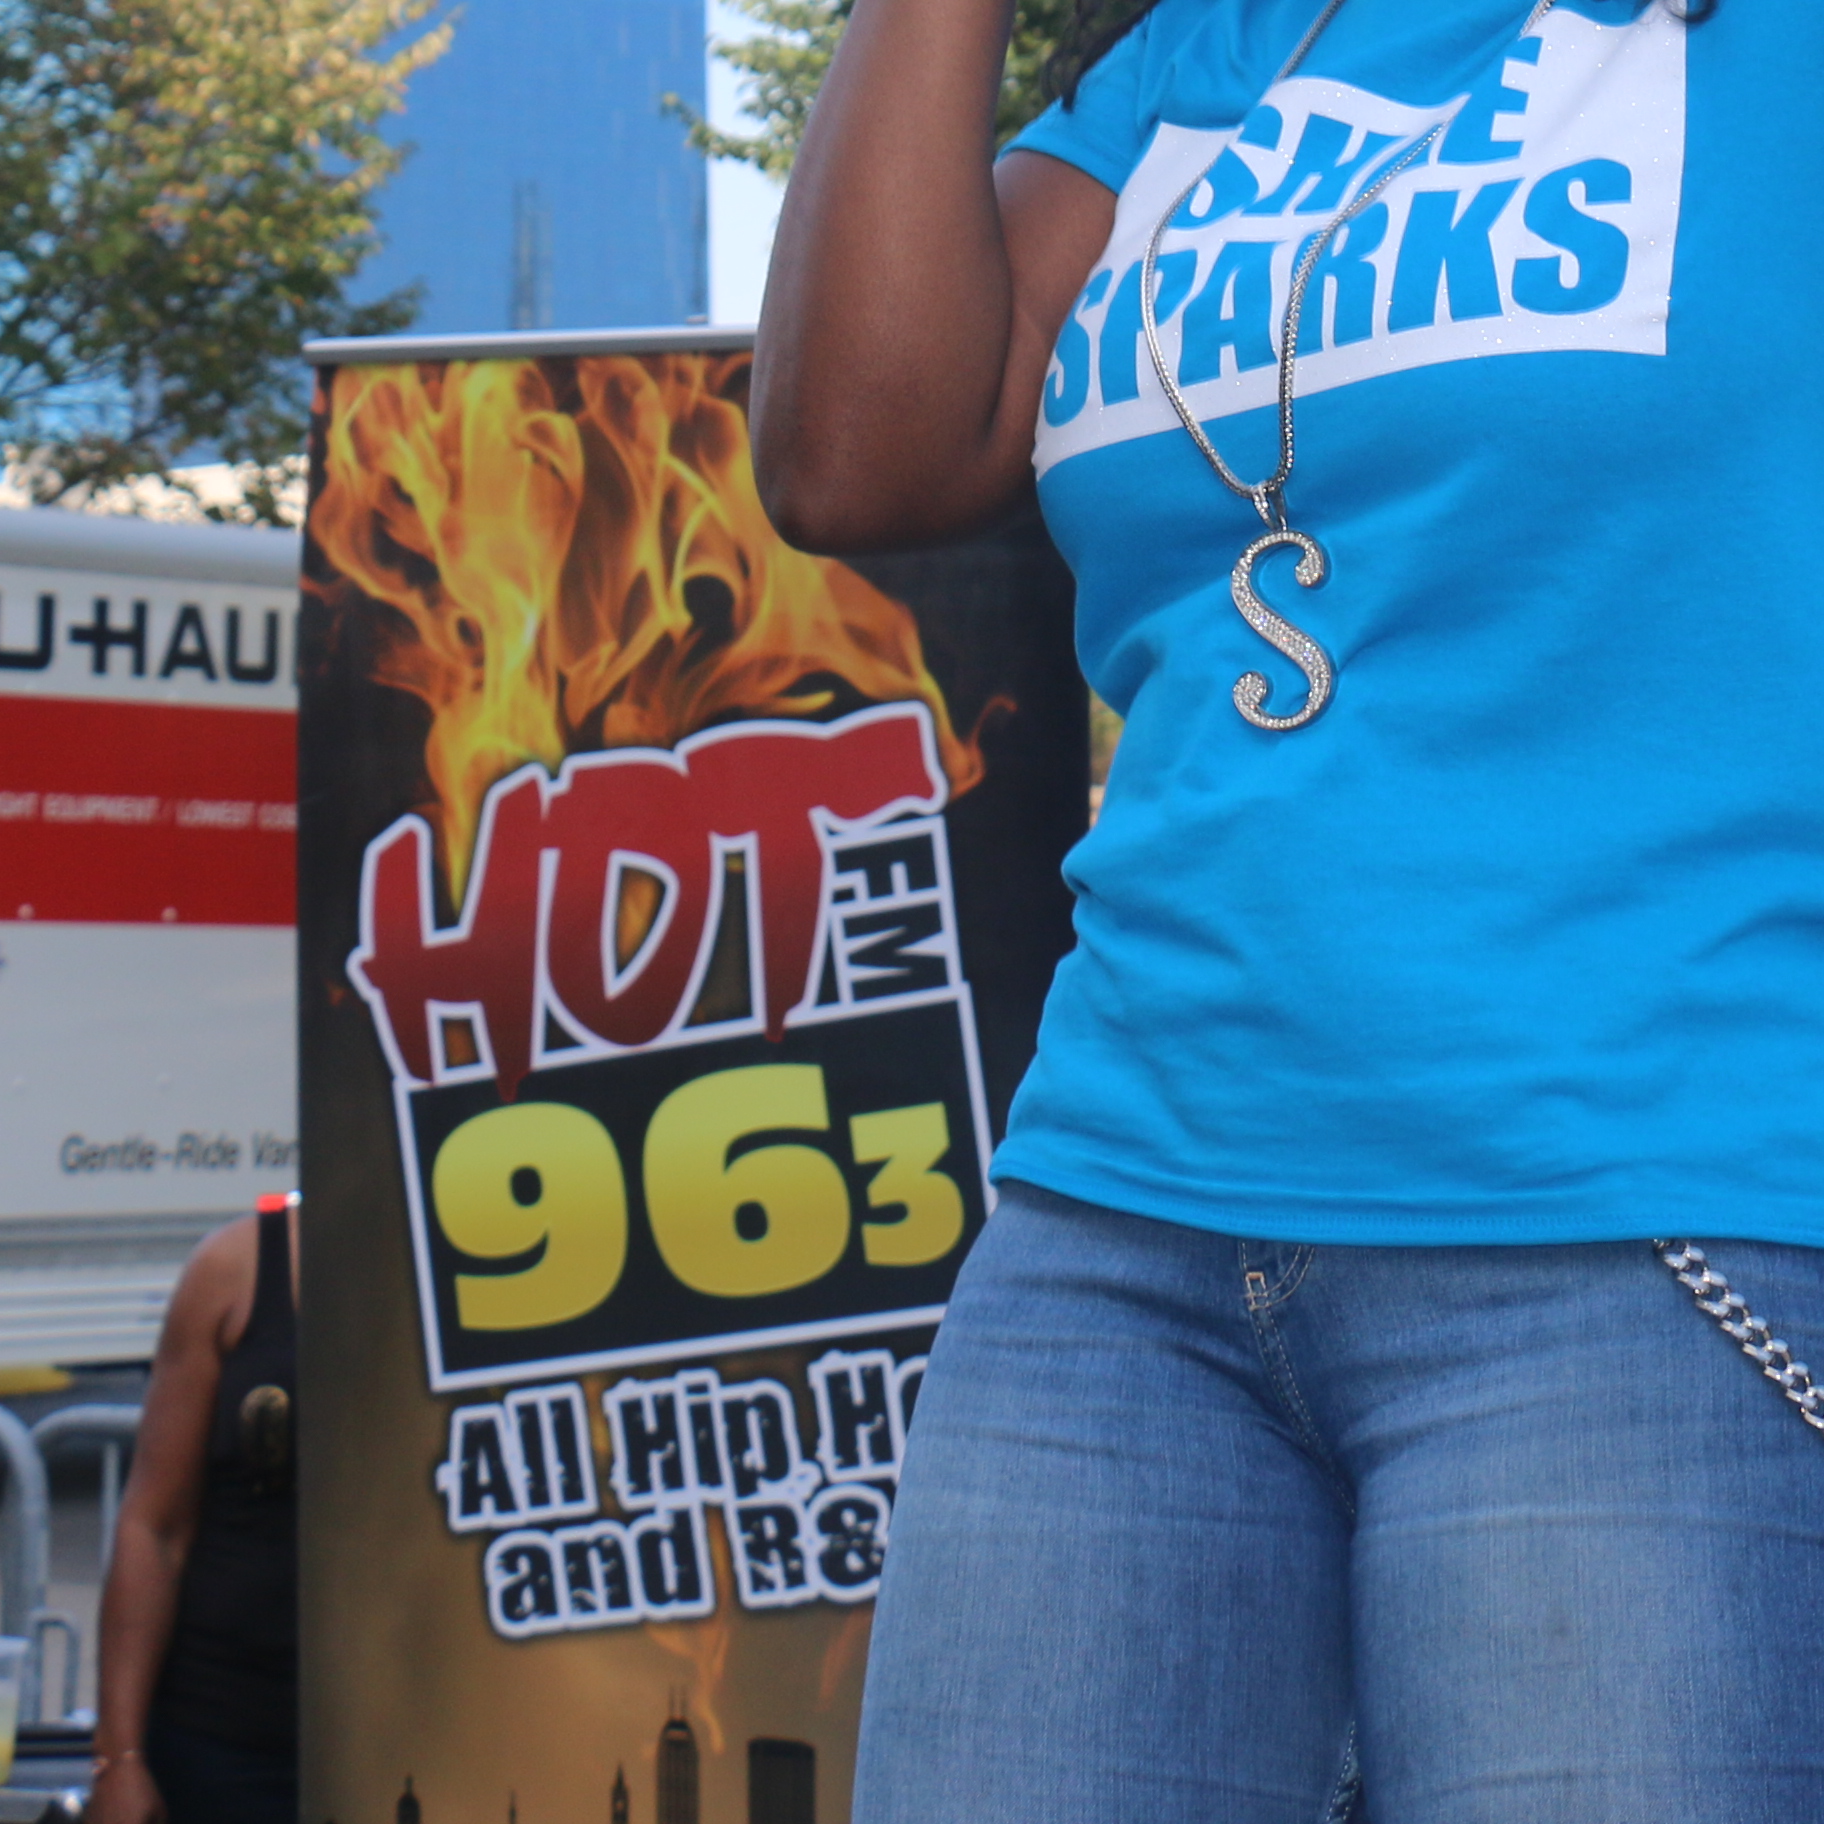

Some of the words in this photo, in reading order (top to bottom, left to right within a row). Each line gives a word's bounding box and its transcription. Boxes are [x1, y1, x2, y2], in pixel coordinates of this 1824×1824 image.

[1043, 157, 1633, 428] SPARKS
[354, 702, 946, 1100] HOT
[831, 831, 952, 1004] FM
[60, 1132, 240, 1173] Gentle-Ride
[446, 1385, 595, 1526] All
[488, 1504, 712, 1634] and
